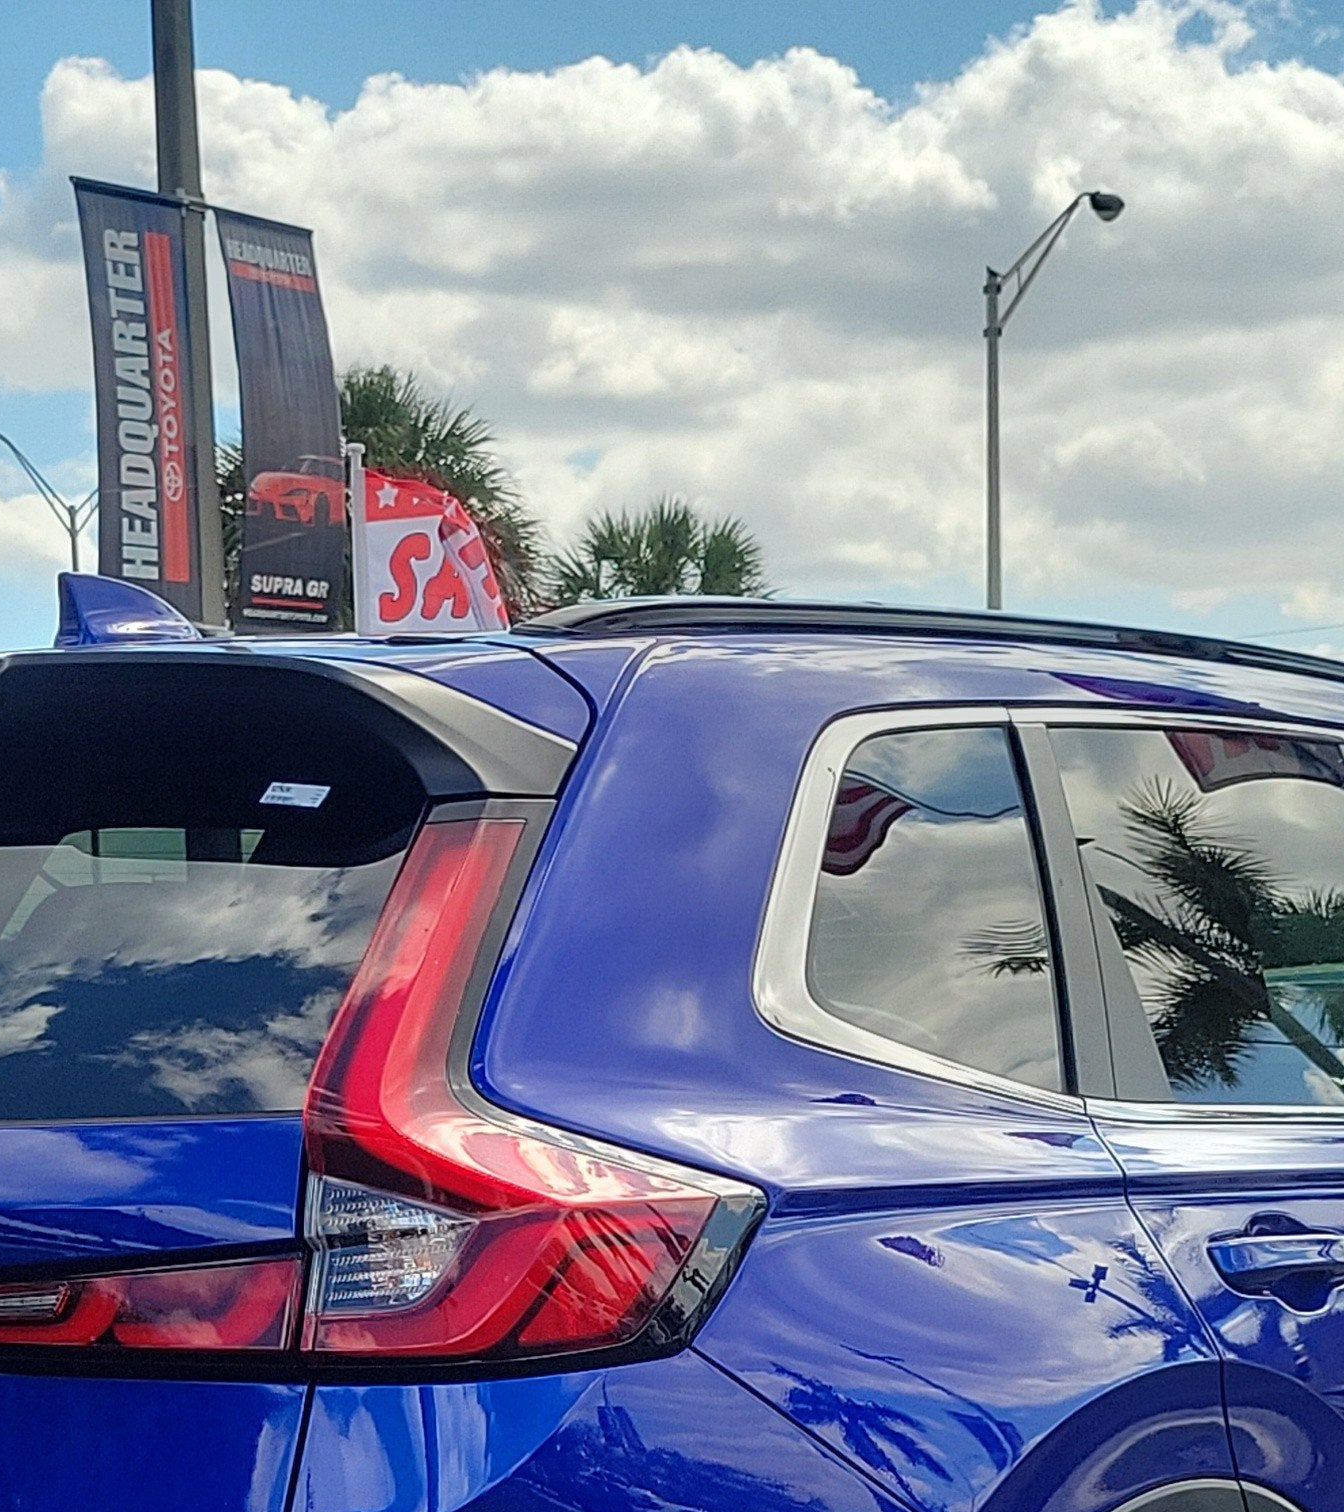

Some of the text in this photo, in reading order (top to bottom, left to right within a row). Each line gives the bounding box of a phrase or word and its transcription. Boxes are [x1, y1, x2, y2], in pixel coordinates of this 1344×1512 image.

[104, 229, 160, 581] HEADQUARTER
[156, 328, 179, 457] TOYOTA
[250, 574, 330, 599] SUPRA GR
